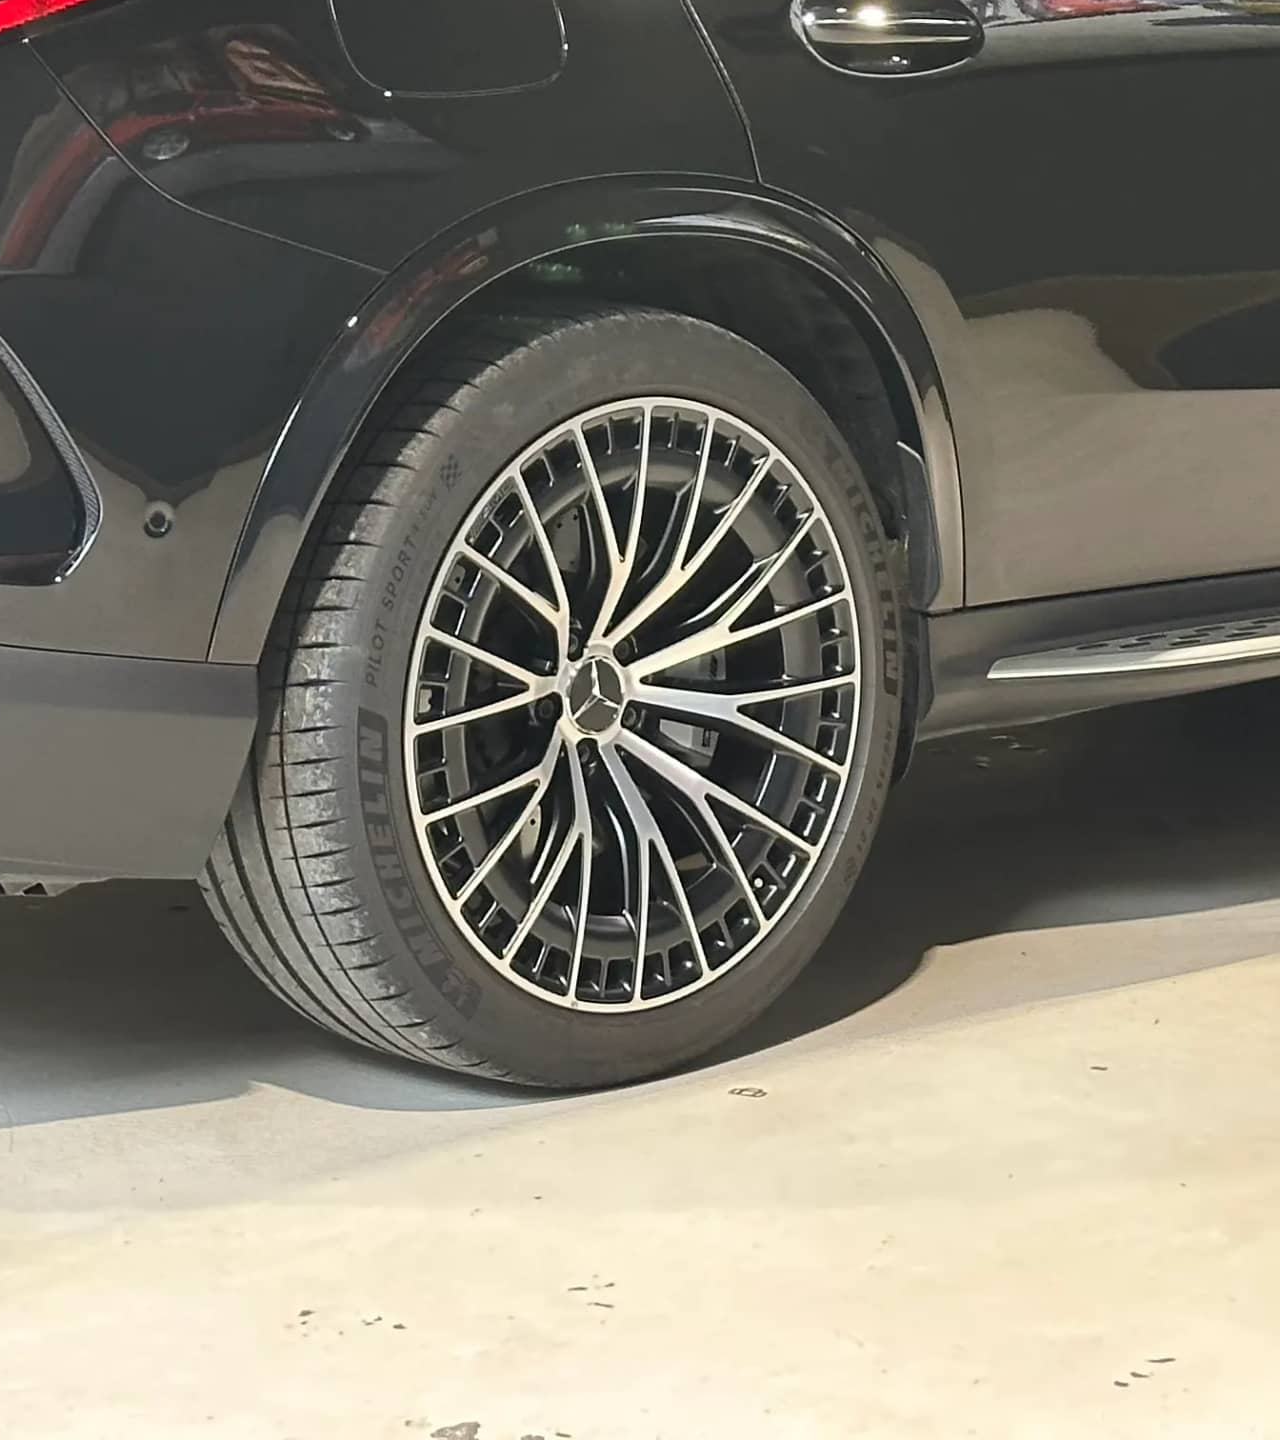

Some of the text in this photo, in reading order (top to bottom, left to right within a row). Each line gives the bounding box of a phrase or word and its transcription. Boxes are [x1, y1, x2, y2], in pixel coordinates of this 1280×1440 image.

[362, 621, 389, 689] PILOT
[382, 534, 418, 612] SPORT
[358, 723, 453, 972] MICHELIN
